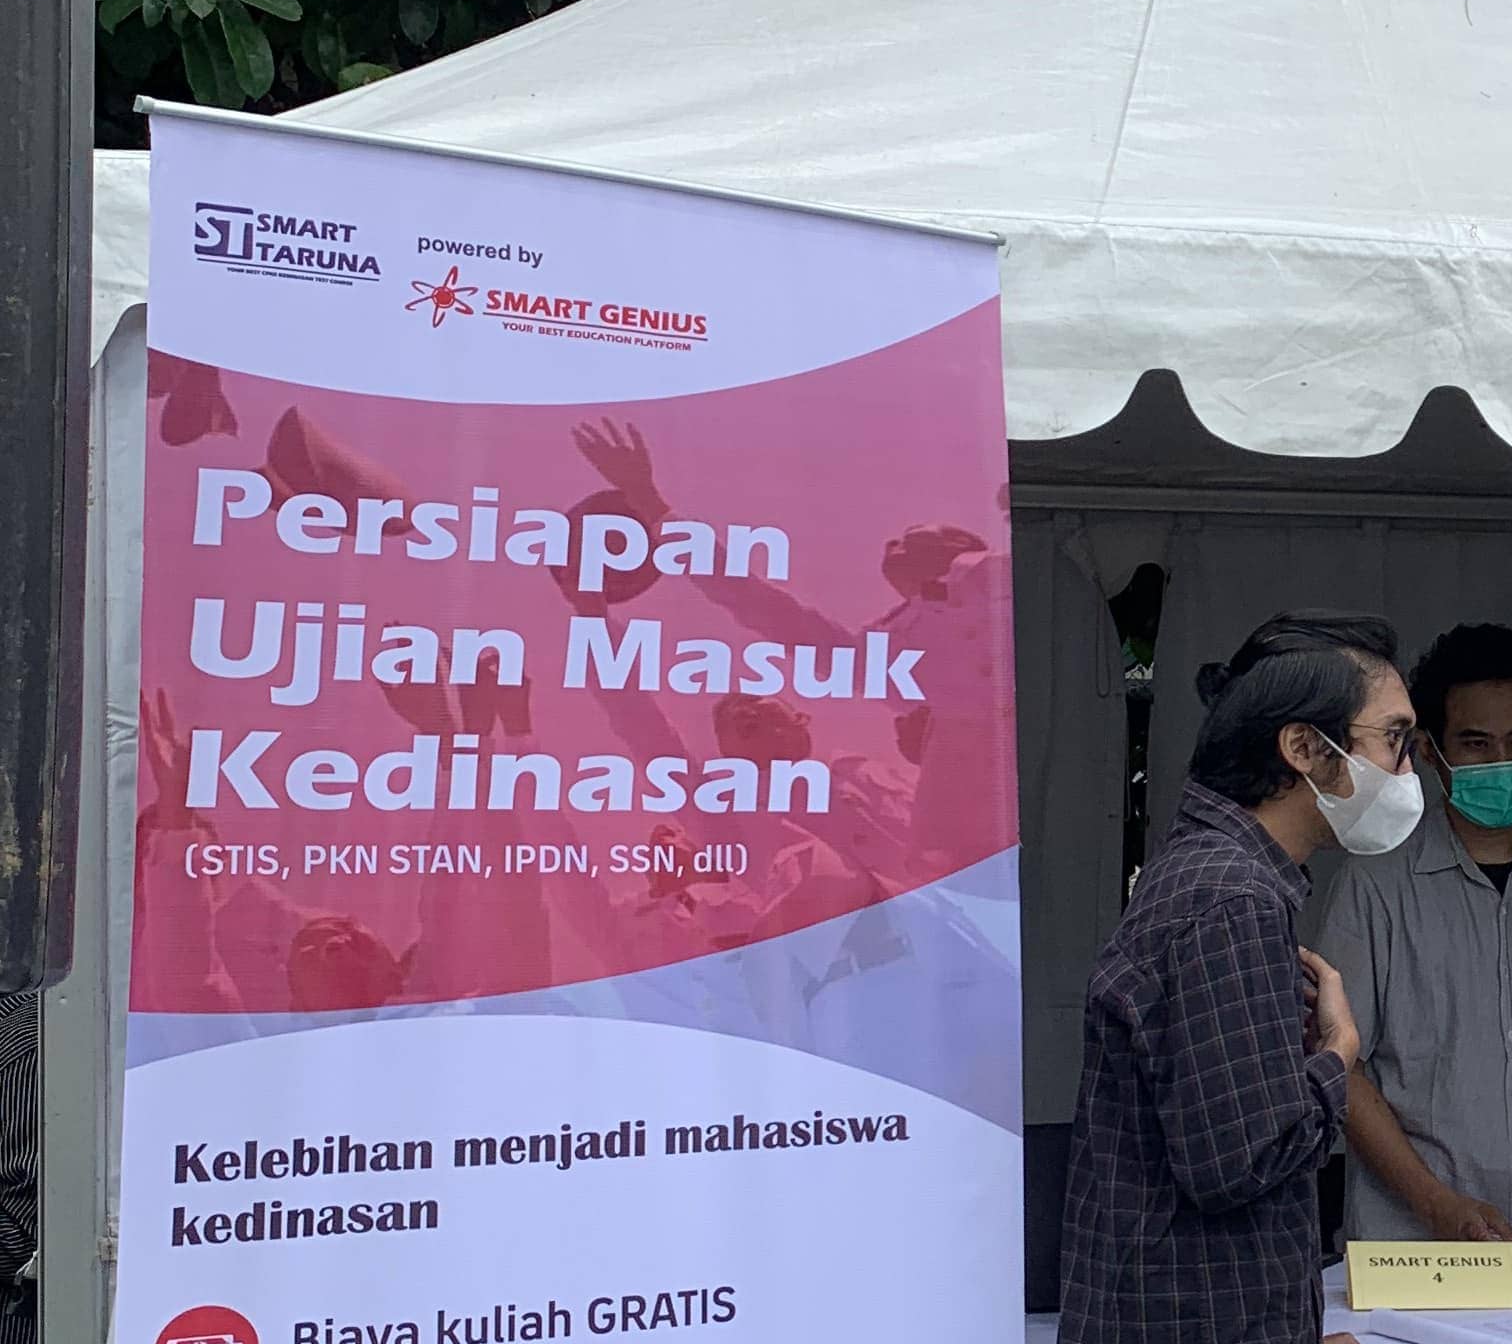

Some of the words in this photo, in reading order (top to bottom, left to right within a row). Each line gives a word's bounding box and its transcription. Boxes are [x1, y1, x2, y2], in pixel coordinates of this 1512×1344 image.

[257, 214, 357, 242] SMART
[256, 242, 381, 275] TARUNA
[418, 237, 510, 260] powered
[519, 246, 543, 268] by
[487, 290, 592, 320] SMART
[600, 304, 706, 335] GENIUS
[503, 322, 533, 333] YOUR
[539, 327, 564, 336] BEST
[567, 330, 631, 344] EDUCATION
[635, 338, 691, 350] PLATFORM
[194, 468, 789, 592] Persiapan
[191, 599, 524, 705] Ujian
[564, 616, 925, 700] Masuk
[186, 730, 830, 813] Kedinasan
[186, 844, 289, 880] (STIS,
[305, 845, 377, 874] PKN
[390, 845, 491, 878] STAN,
[506, 845, 598, 877] IPDN,
[610, 845, 683, 877] SSN,
[694, 844, 747, 875] dll)
[175, 1135, 432, 1184] Kelebihan
[454, 1120, 645, 1170] menjadi
[666, 1111, 910, 1154] mahasiswa
[172, 1201, 437, 1246] kedinasan
[1369, 1257, 1431, 1266] SMART
[1437, 1257, 1502, 1266] GENIUS
[1433, 1273, 1442, 1283] 4
[588, 1287, 735, 1334] GRATIS
